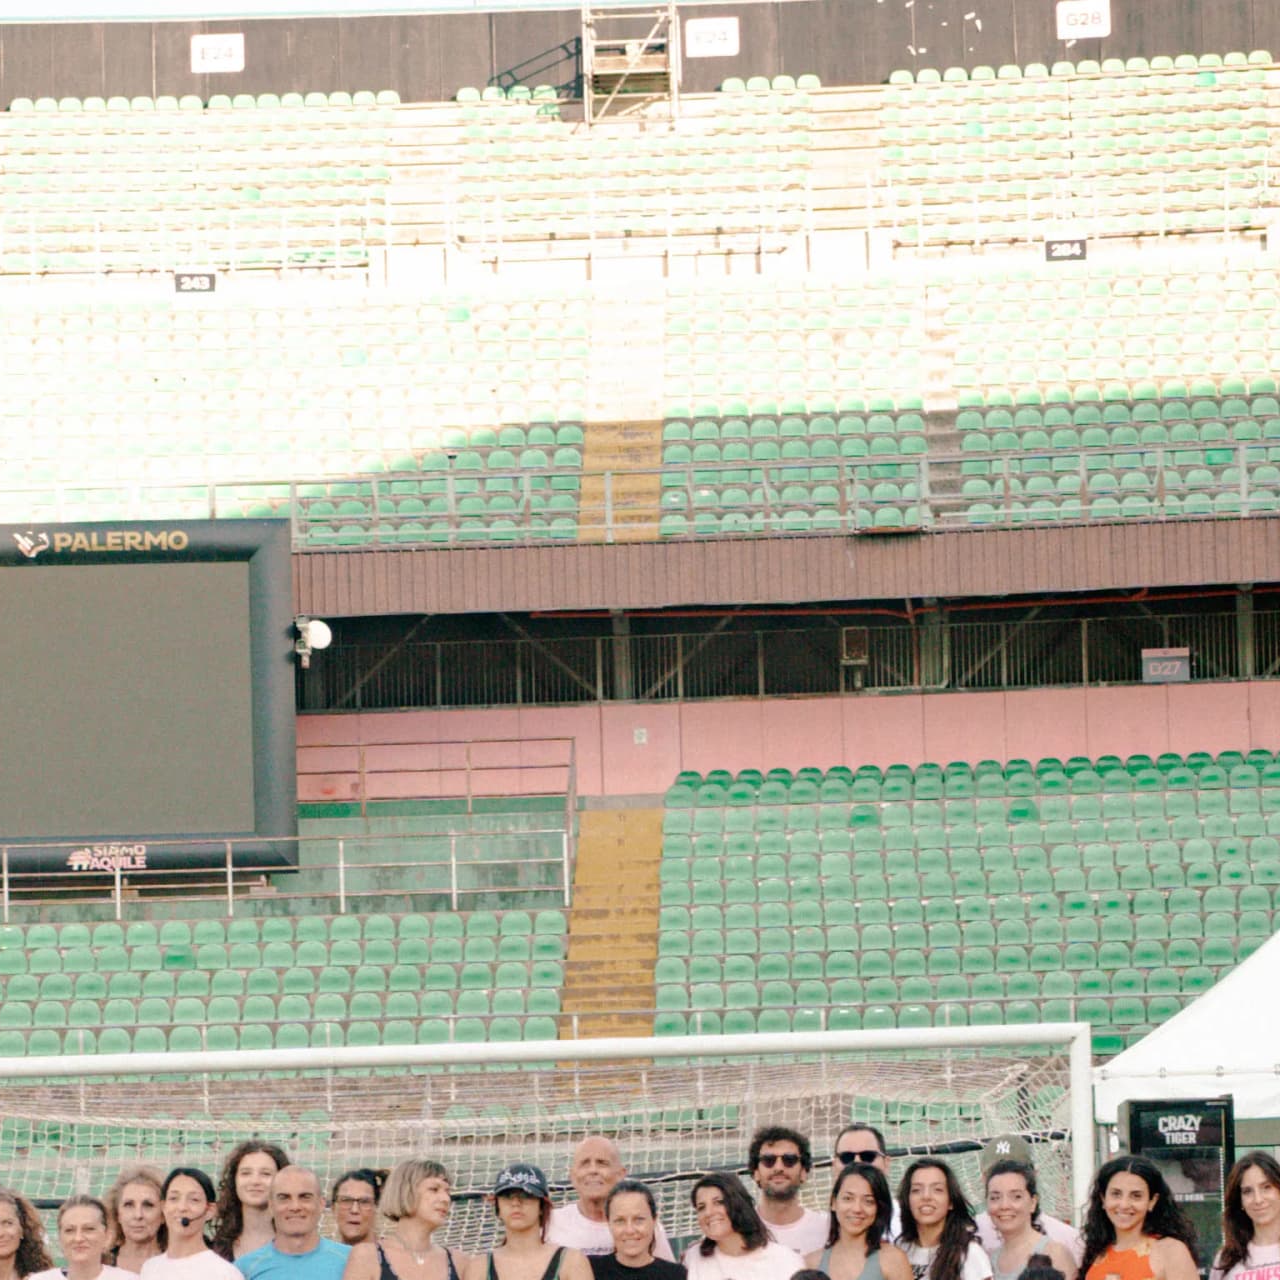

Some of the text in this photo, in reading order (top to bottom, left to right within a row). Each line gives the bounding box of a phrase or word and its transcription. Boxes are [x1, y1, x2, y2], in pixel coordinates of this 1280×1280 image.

[1066, 12, 1102, 26] G28
[180, 276, 210, 290] 243
[54, 531, 188, 552] PALERMO
[1158, 1114, 1202, 1133] CRAZY
[1165, 1132, 1197, 1145] TIGER
